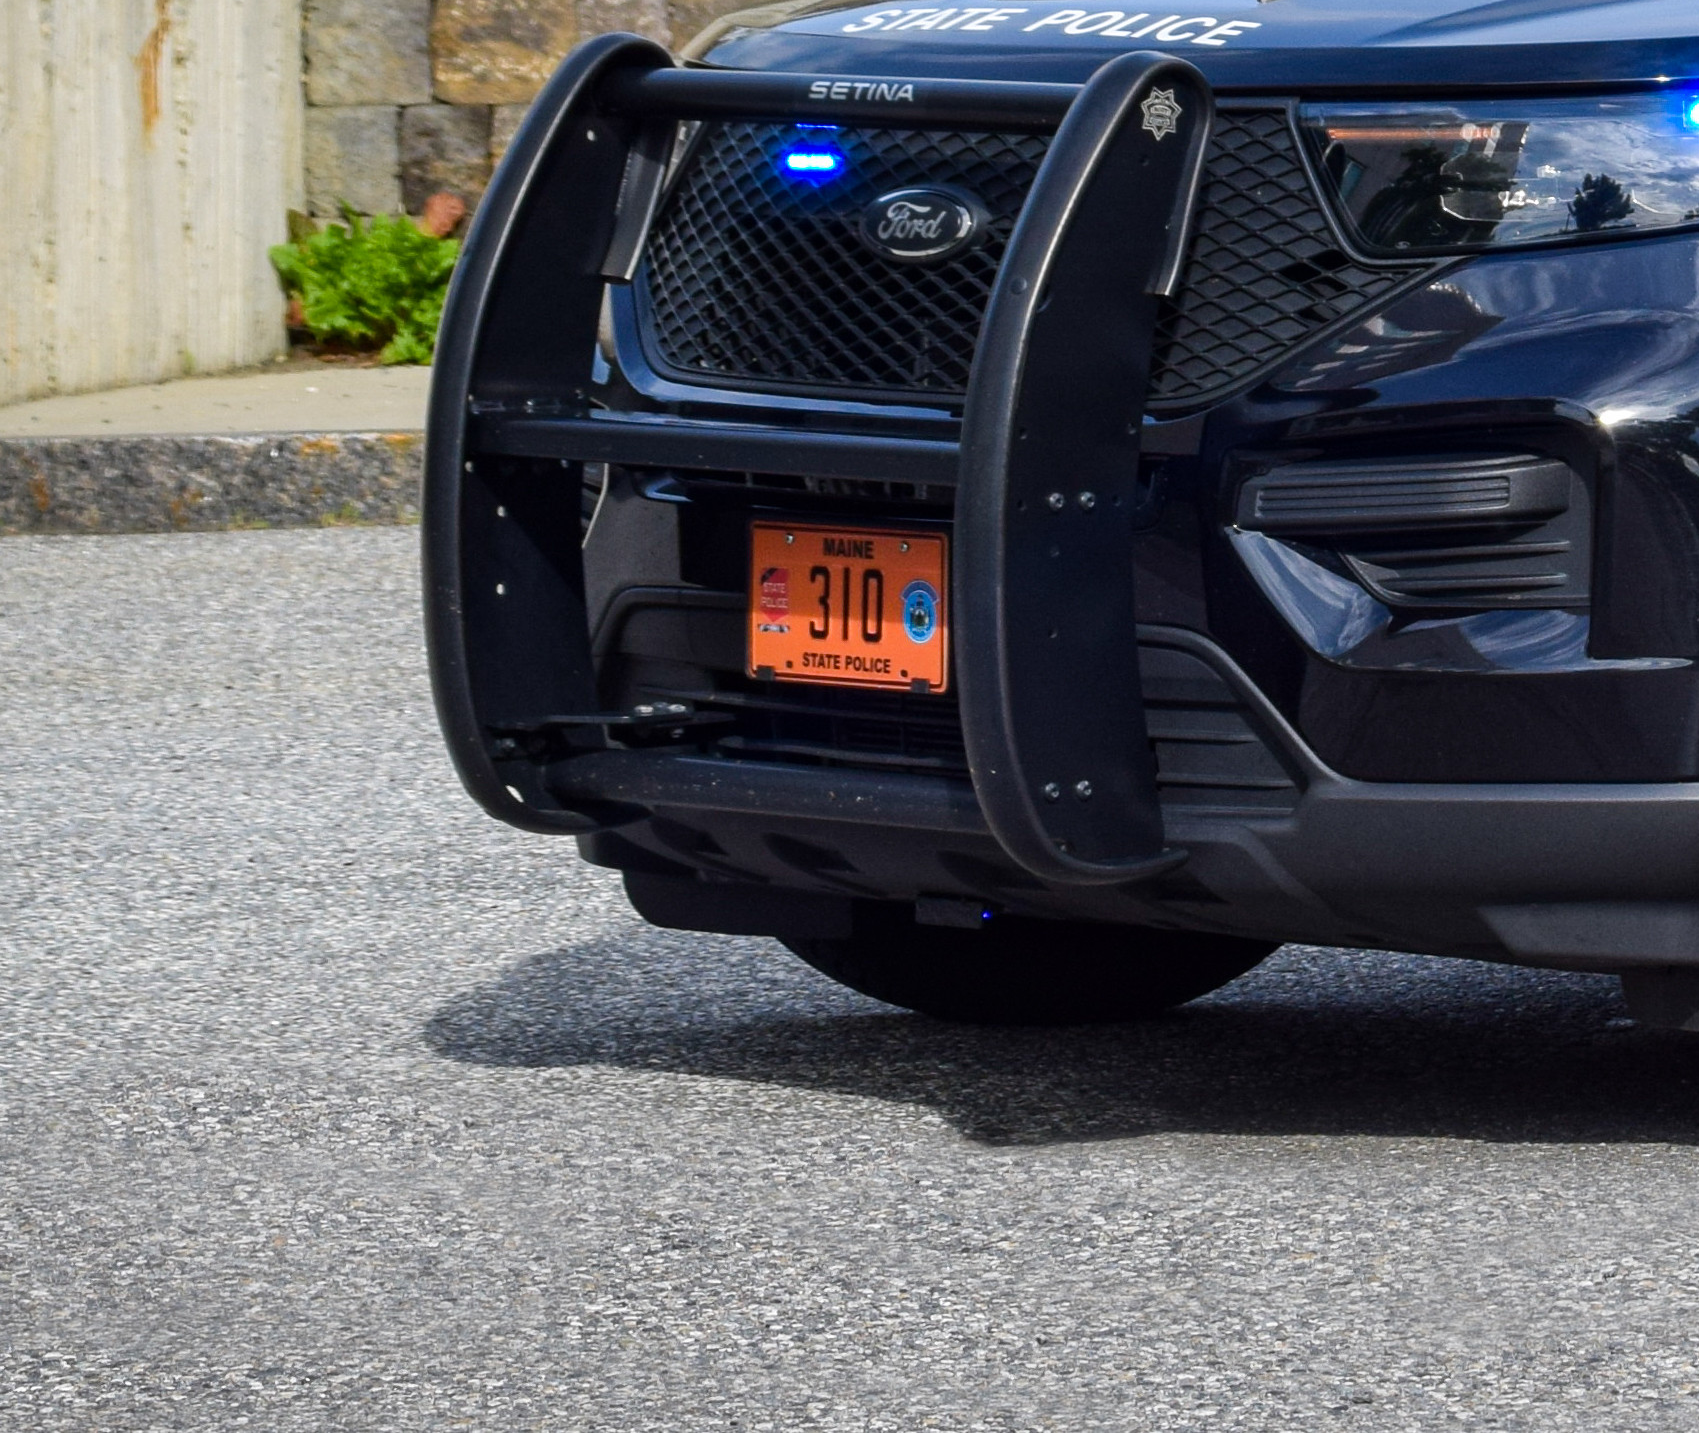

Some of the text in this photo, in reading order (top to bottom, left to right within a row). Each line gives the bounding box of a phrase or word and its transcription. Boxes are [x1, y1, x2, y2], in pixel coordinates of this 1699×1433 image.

[842, 8, 1262, 46] STATE POLICE
[808, 81, 914, 102] SETINA
[878, 201, 947, 239] Ford
[823, 537, 875, 559] MAINE
[763, 582, 787, 594] STATE
[762, 596, 789, 609] POLICE
[809, 566, 884, 642] 310
[802, 651, 892, 674] STATE POLICE
